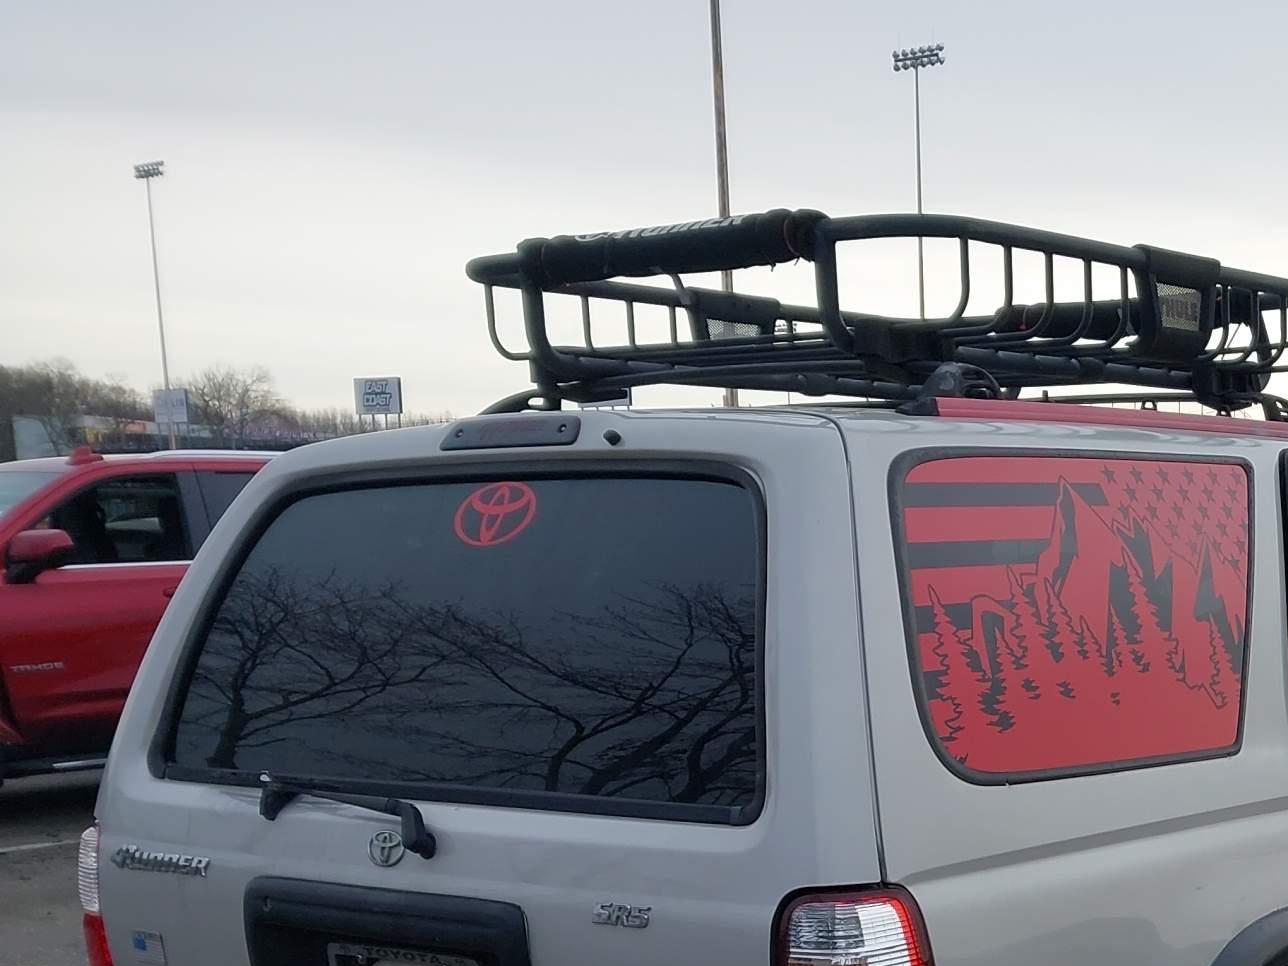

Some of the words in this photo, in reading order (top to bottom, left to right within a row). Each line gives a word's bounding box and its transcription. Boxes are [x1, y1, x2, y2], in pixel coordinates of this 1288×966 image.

[365, 381, 388, 393] EAST
[363, 393, 392, 407] COAST
[364, 947, 442, 966] TOYOTA
